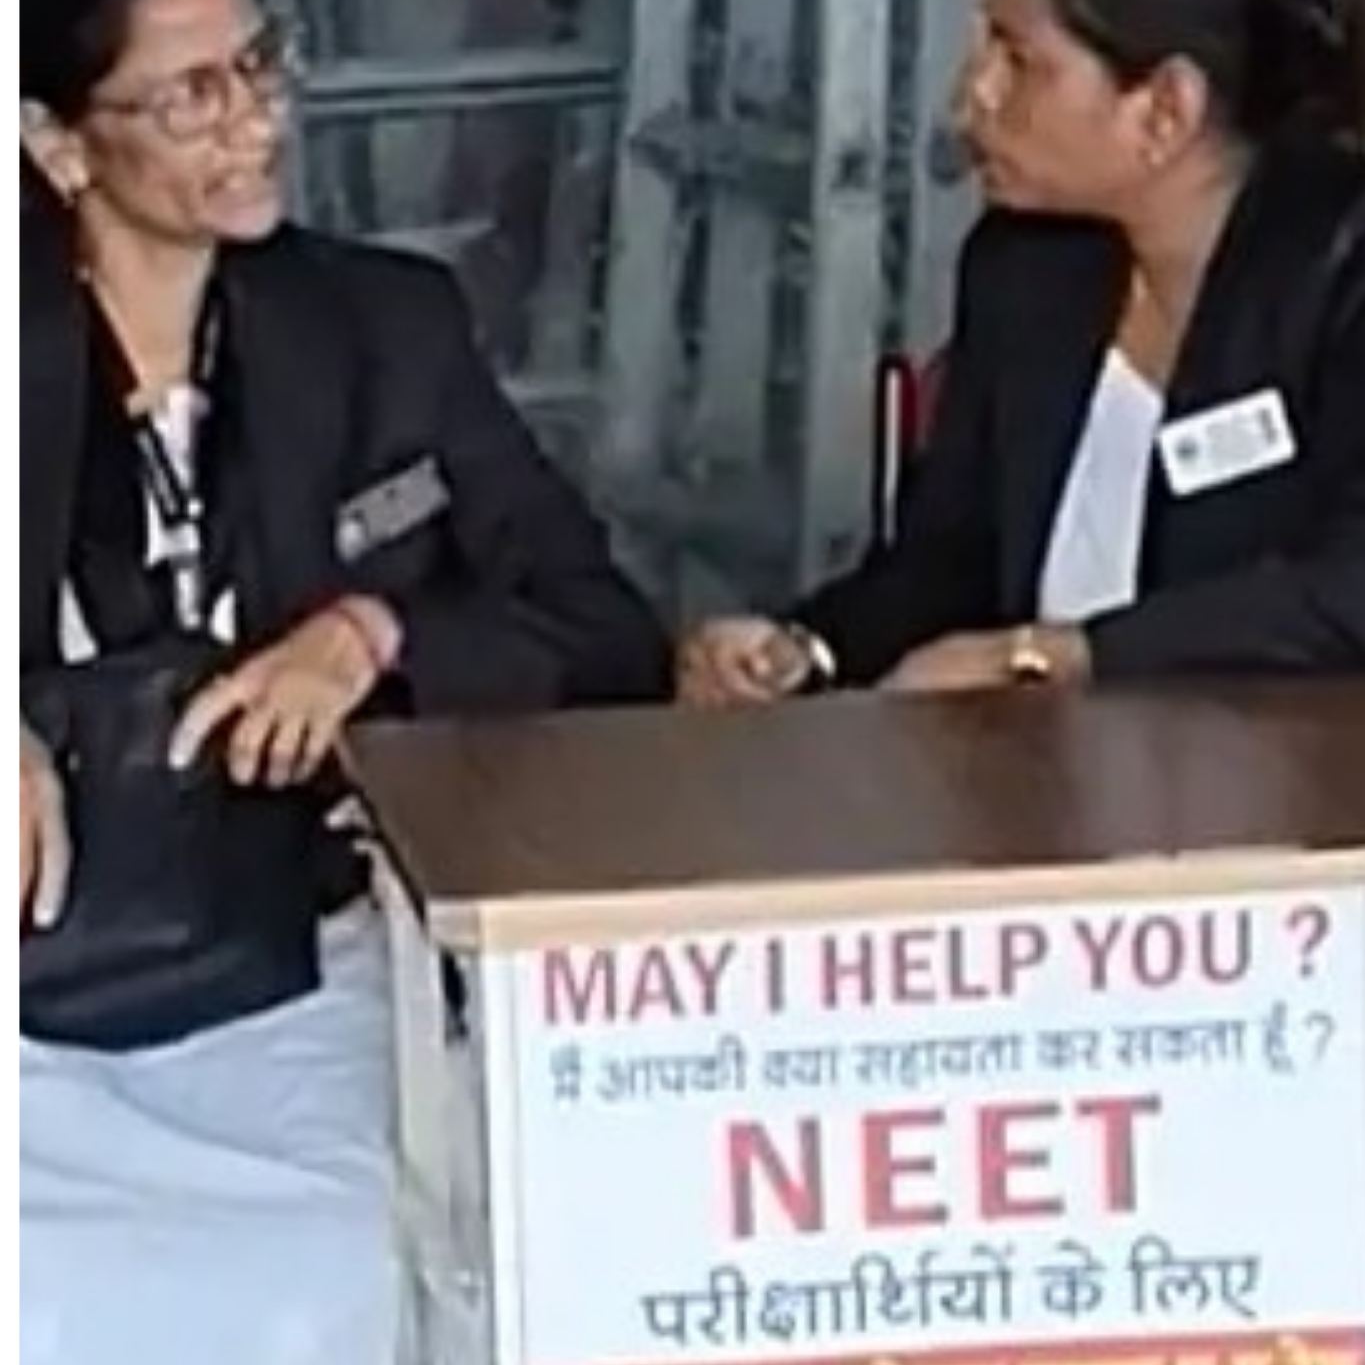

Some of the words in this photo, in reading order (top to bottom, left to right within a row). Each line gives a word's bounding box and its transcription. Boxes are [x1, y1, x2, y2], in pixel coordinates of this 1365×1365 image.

[543, 940, 737, 1026] MAY
[766, 935, 786, 1013] I
[820, 921, 1049, 1010] HELP
[1072, 909, 1252, 992] YOU
[1285, 905, 1331, 979] ?
[598, 1032, 748, 1100] आपकी
[763, 1046, 842, 1088] क्या
[853, 1033, 1025, 1089] सहायता
[1036, 1028, 1102, 1069] कर
[1112, 1018, 1246, 1066] सकता
[1304, 1011, 1336, 1067] ?
[722, 1094, 1161, 1241] NEET
[1035, 1238, 1106, 1320] के
[1127, 1231, 1262, 1320] लिए
